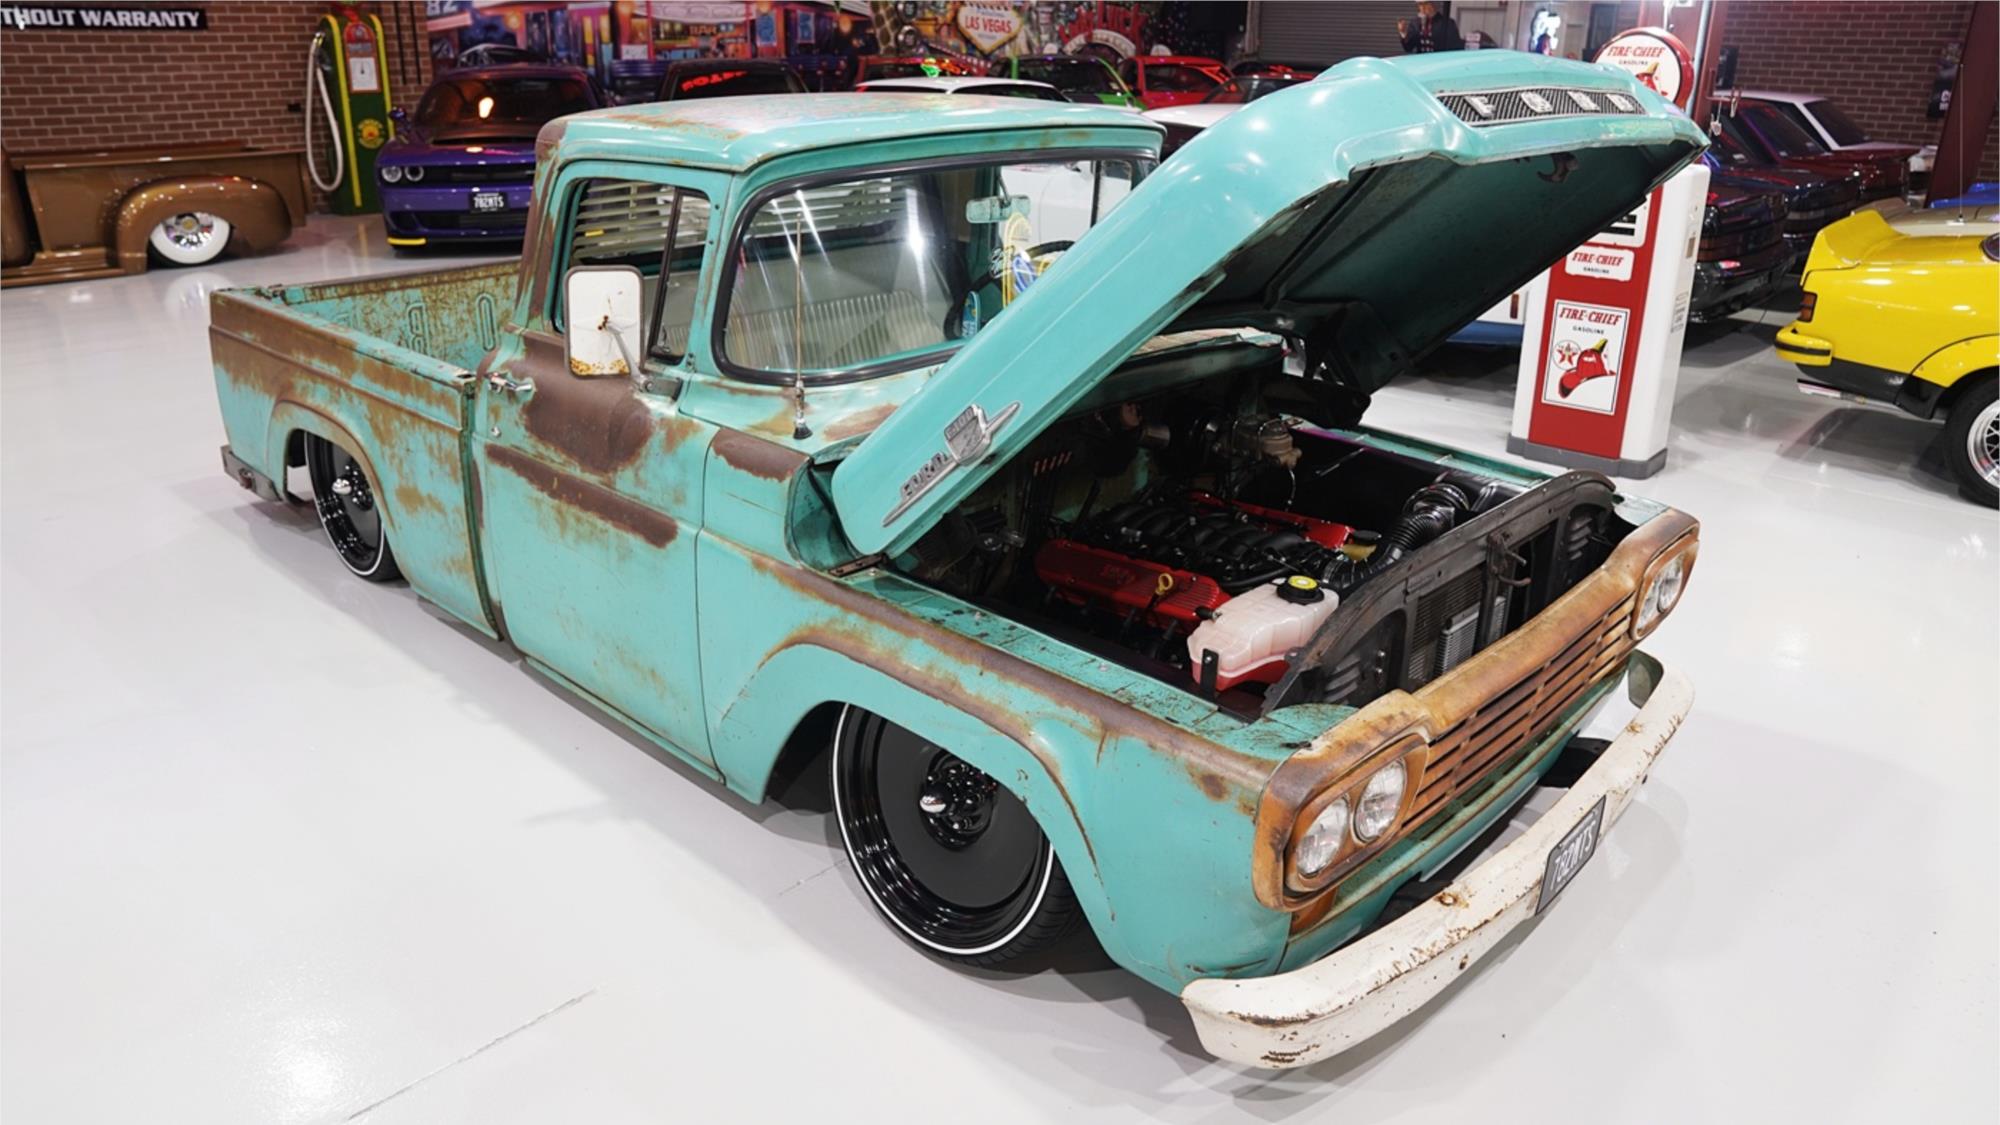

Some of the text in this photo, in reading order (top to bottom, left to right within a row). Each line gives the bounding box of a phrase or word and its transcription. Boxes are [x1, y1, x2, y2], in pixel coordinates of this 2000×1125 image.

[80, 10, 200, 27] WARRANTY
[965, 16, 1012, 33] LAS VEGAS
[1607, 46, 1666, 57] FIRE-CHIEF
[1464, 91, 1635, 118] FORD
[1572, 252, 1624, 267] FIRE-CHIEF
[1559, 307, 1623, 326] FIRE-CHIEF
[901, 451, 949, 498] FORD
